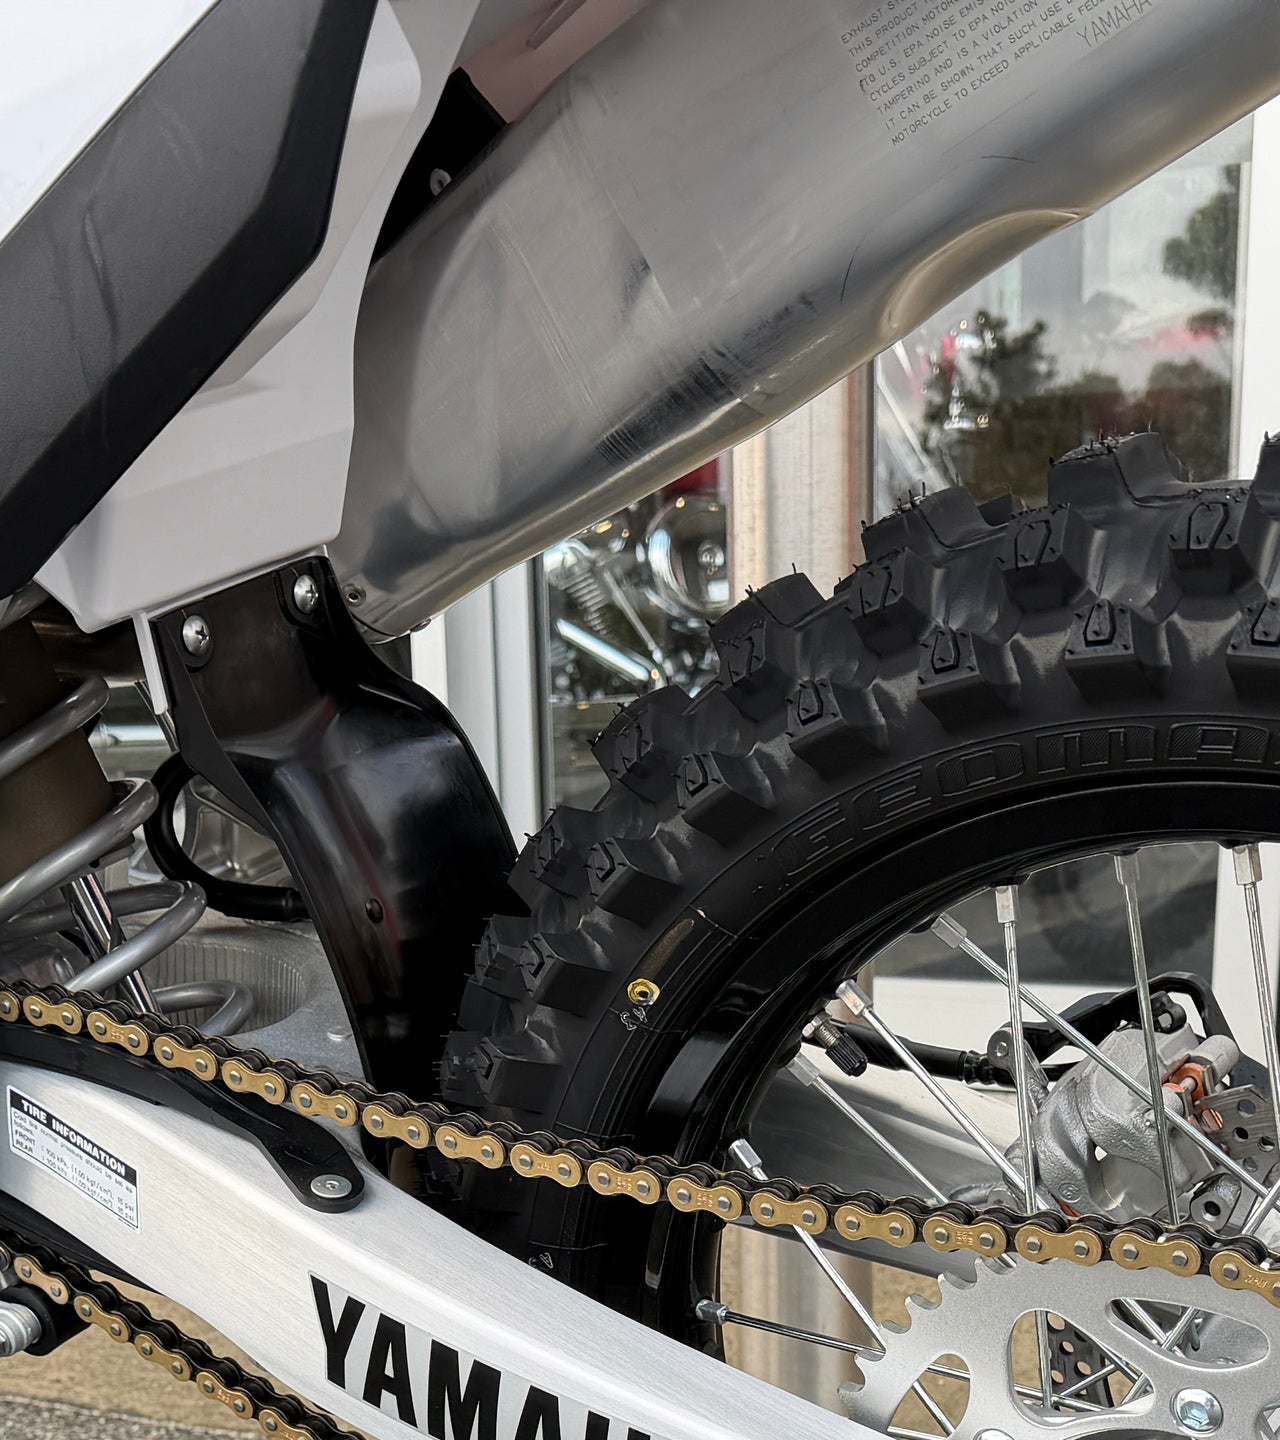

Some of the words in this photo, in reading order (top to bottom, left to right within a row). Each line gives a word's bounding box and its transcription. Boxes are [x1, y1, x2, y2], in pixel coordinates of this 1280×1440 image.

[840, 8, 883, 44] EXHAUST
[848, 37, 872, 57] THIS
[875, 3, 918, 38] PRODUCT
[855, 23, 920, 73] COMPETITION
[862, 74, 876, 88] TO
[878, 59, 901, 76] U.S.
[904, 40, 923, 58] EPA
[926, 15, 957, 41] NOISE
[870, 72, 906, 102] CYCLES
[908, 40, 950, 75] SUBJECT
[952, 29, 966, 43] TO
[968, 14, 989, 32] EPA
[934, 57, 954, 77] AND
[957, 47, 969, 60] IS
[972, 40, 980, 49] A
[982, 0, 1039, 41] VIOLATION
[885, 118, 896, 131] IT
[900, 102, 921, 120] CAN
[922, 89, 938, 104] BE
[940, 63, 975, 92] SHOWN
[977, 41, 1004, 65] THAT
[1008, 20, 1037, 45] SUCH
[1040, 3, 1063, 22] USE
[891, 99, 953, 147] MOTORCYCLE
[954, 87, 969, 101] TO
[970, 59, 1010, 91] EXCEED
[1014, 12, 1077, 62] APPLICABLE
[21, 1099, 48, 1124] TIRE
[52, 1118, 126, 1177] INFORMATION
